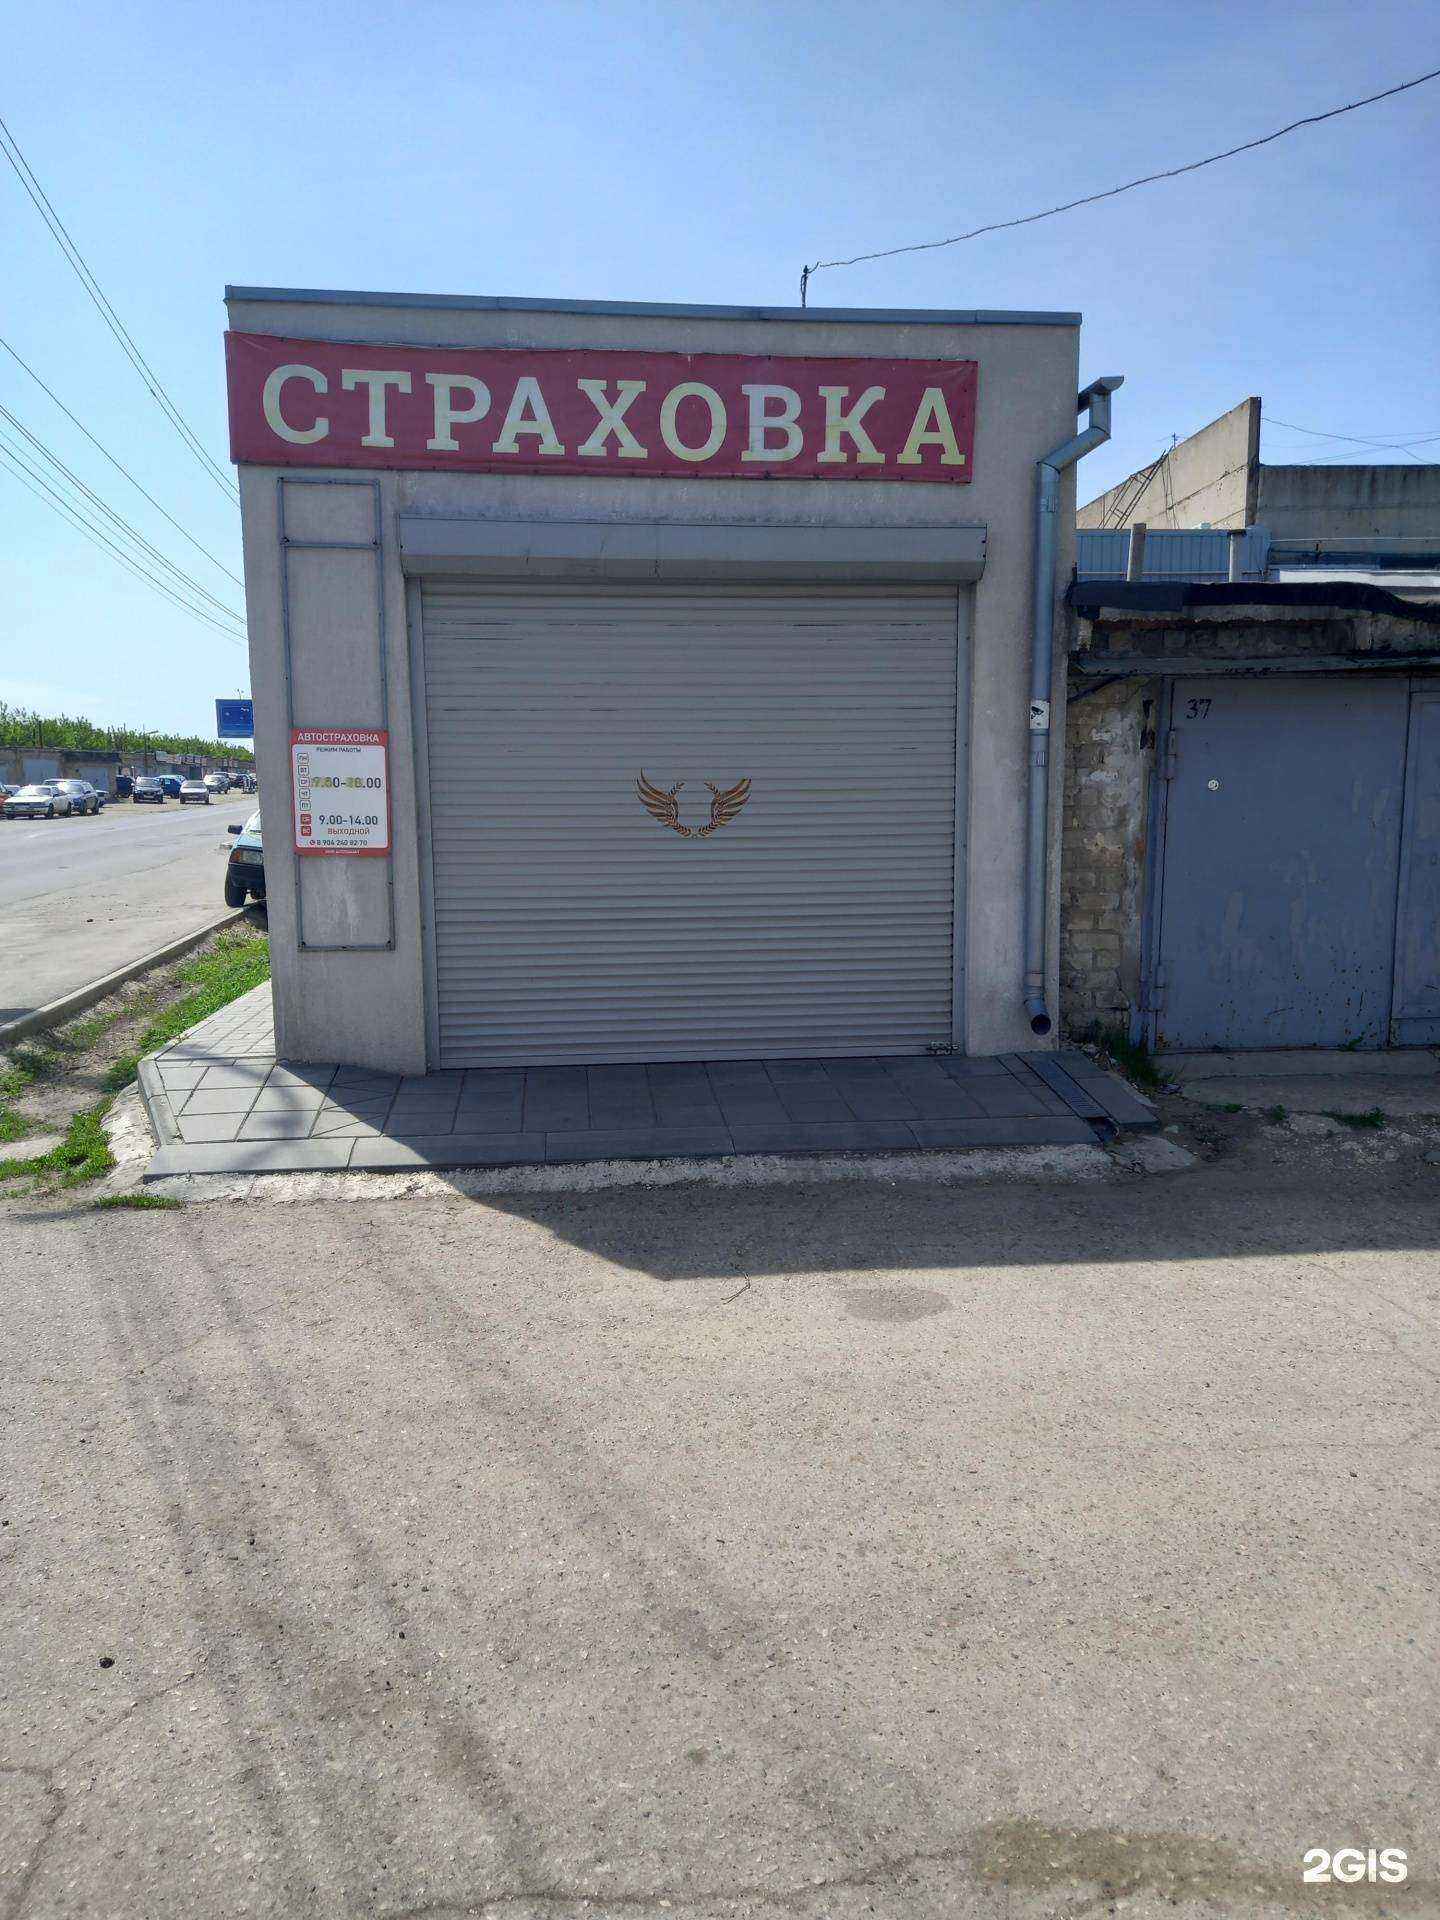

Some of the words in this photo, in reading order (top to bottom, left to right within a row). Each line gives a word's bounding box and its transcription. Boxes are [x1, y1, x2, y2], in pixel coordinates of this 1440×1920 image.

[261, 363, 967, 466] СТРАХОВКА
[1186, 697, 1212, 719] 37
[297, 732, 379, 743] АВТОСТРАХОВКА
[319, 814, 378, 826] 9.00-14.00
[327, 827, 370, 836] ВЫХОДНОЙ
